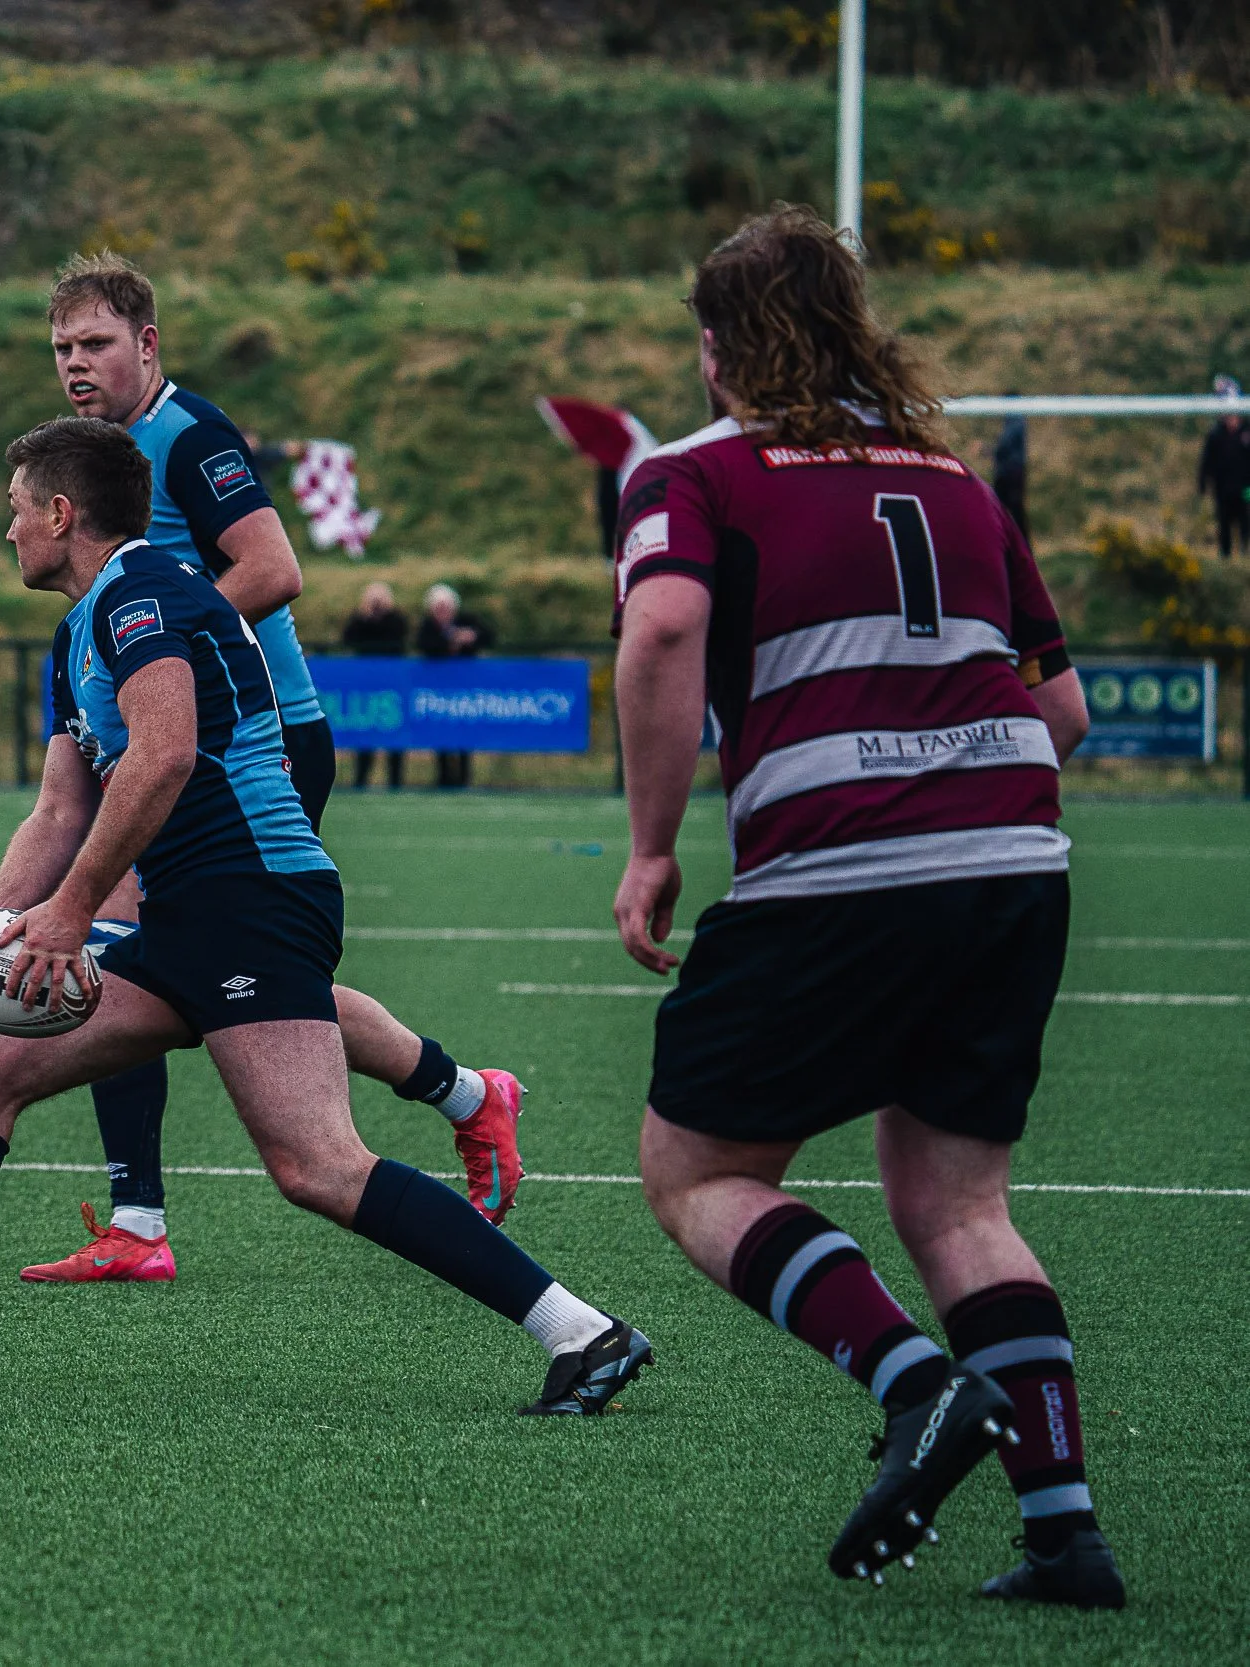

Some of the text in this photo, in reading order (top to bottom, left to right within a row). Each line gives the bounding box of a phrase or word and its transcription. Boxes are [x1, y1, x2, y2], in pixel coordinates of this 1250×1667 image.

[874, 493, 942, 639] 1
[120, 609, 146, 623] Sherry
[917, 722, 1017, 752] FARRELL
[226, 989, 255, 1000] umbro
